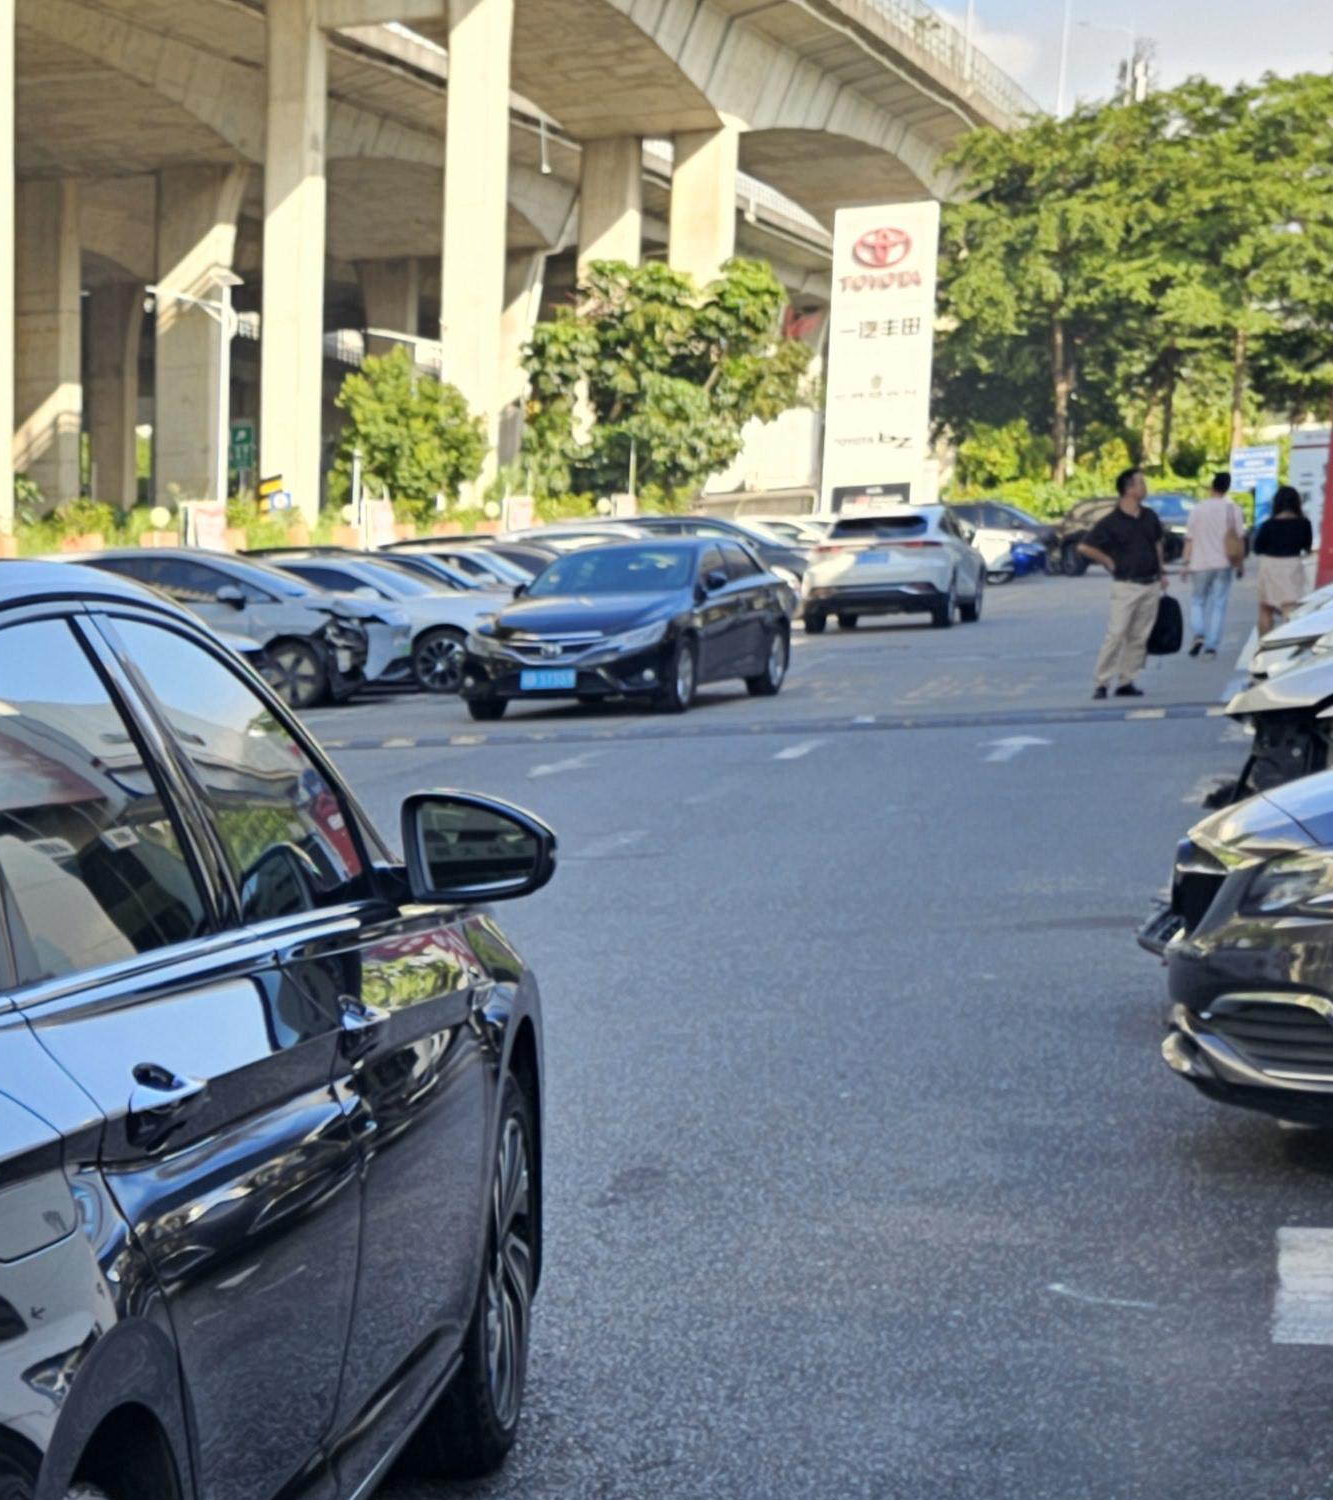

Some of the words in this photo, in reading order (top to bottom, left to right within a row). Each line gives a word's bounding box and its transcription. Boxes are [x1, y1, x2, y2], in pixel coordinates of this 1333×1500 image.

[839, 270, 921, 293] TOYOTA
[840, 316, 921, 339] 一汽丰田
